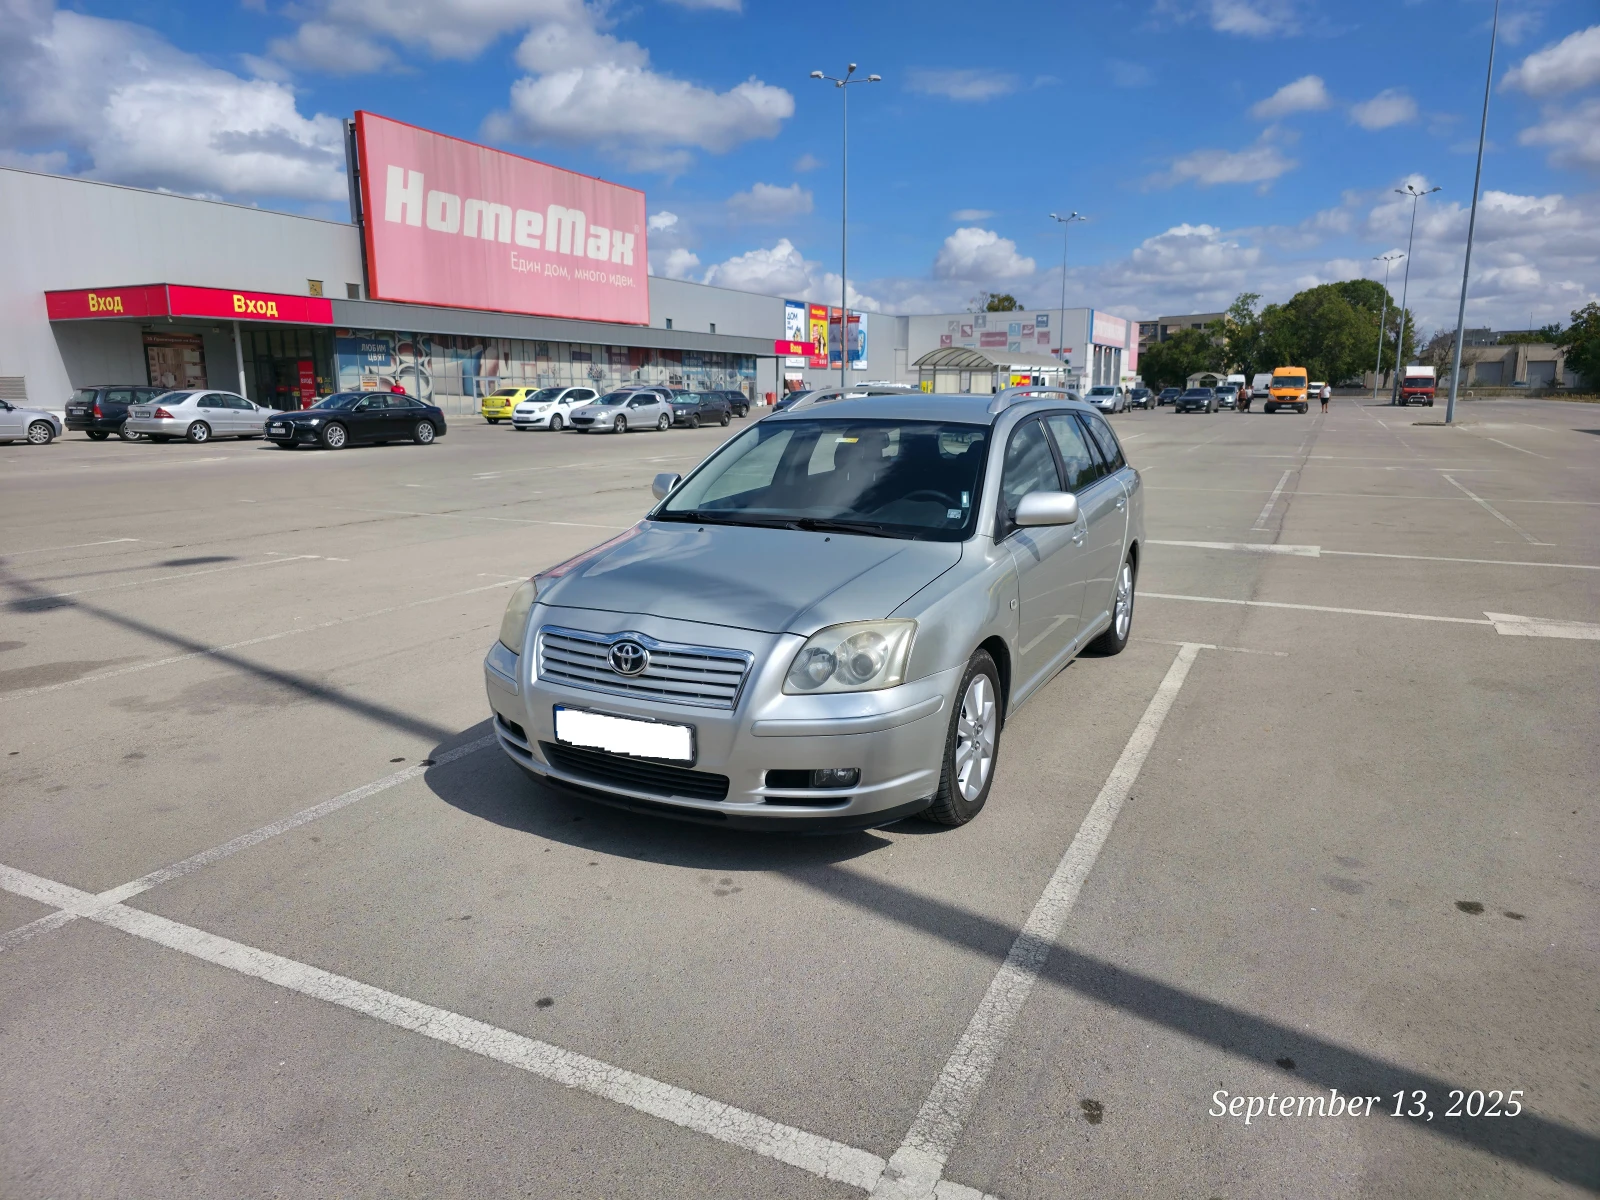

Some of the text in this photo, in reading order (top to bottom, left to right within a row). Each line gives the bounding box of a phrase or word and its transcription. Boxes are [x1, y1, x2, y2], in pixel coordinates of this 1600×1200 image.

[384, 164, 634, 266] HomeMax
[510, 251, 636, 287] Един дом, много идеи.
[88, 293, 124, 313] Вход
[232, 294, 279, 318] Вход
[361, 343, 386, 352] ЛЮБИМ
[367, 353, 386, 362] ЦВЯТ
